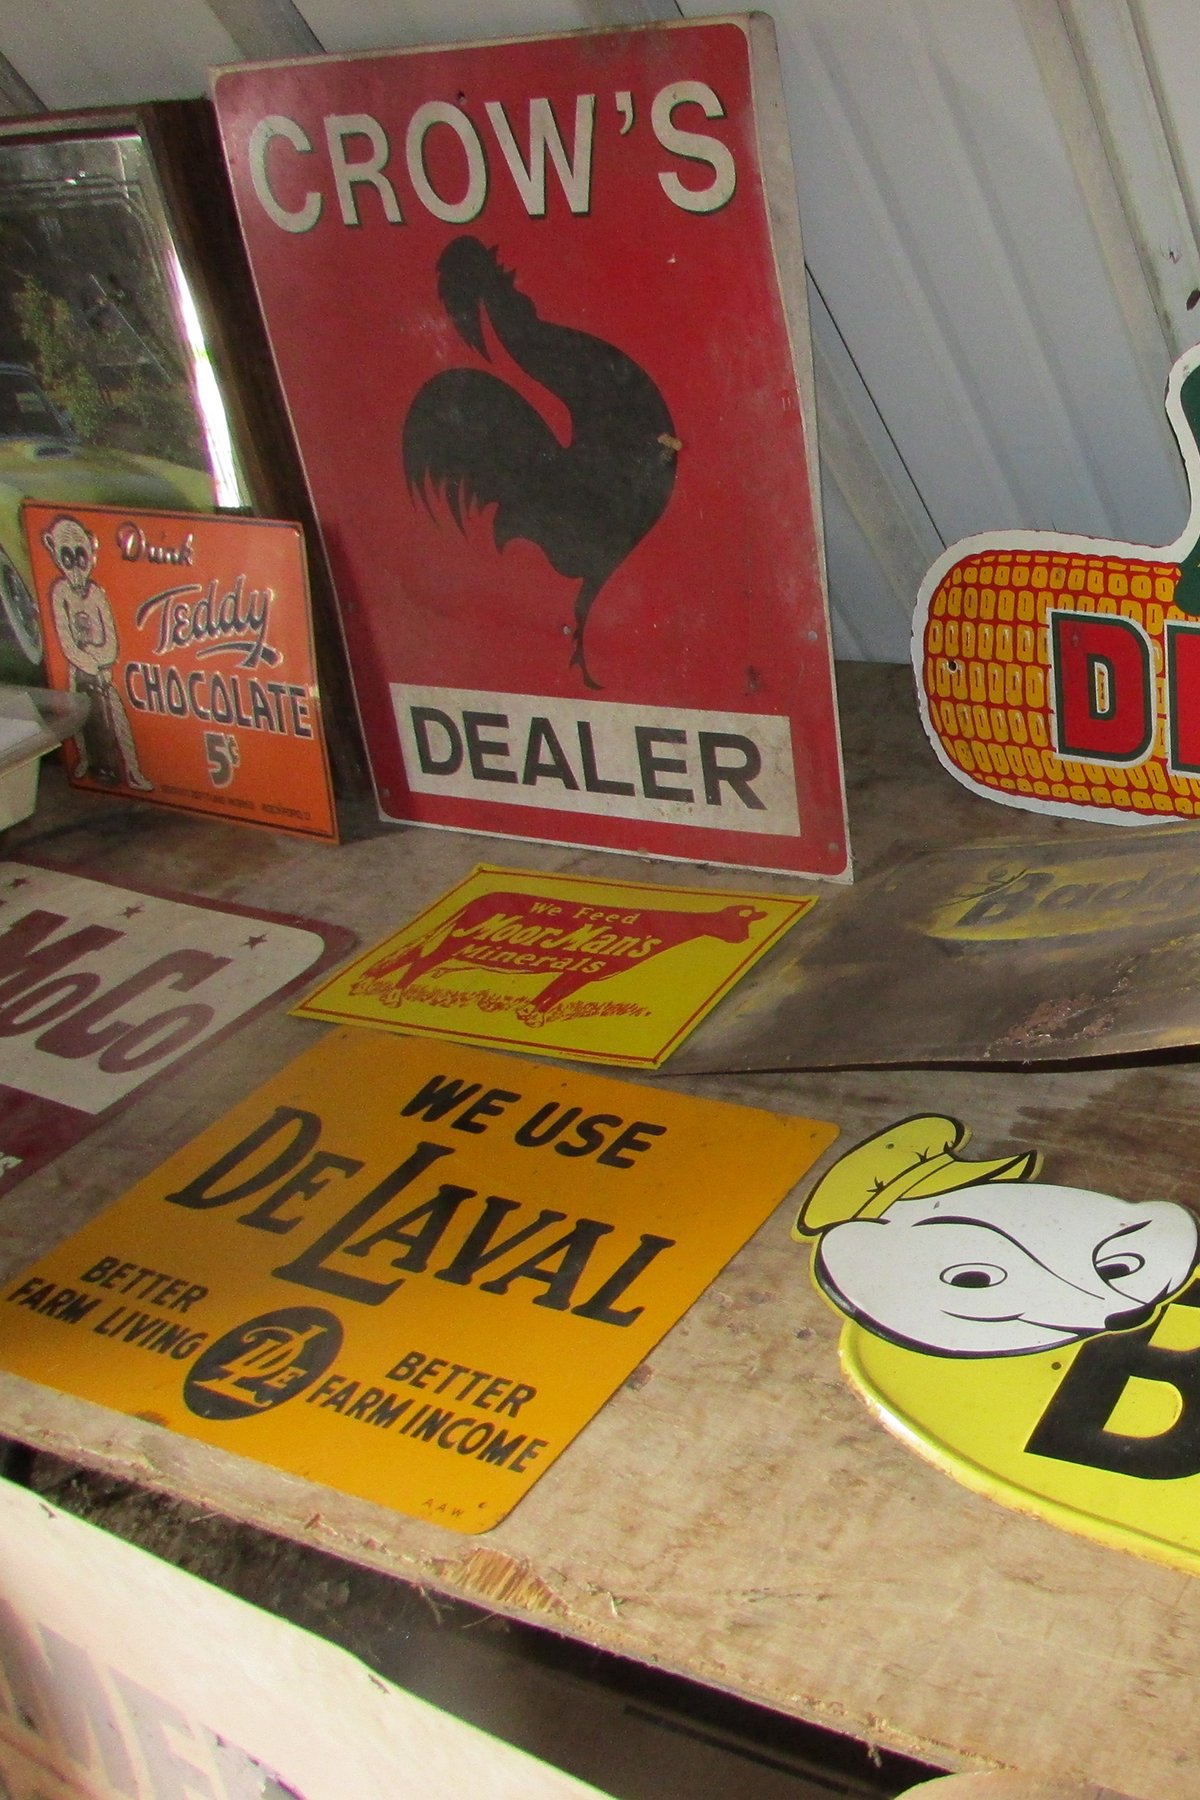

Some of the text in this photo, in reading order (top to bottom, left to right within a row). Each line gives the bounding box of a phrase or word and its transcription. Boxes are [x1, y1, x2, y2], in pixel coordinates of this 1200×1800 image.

[248, 80, 739, 234] CROW'S
[136, 573, 284, 669] Teddy
[124, 661, 315, 740] CHOCOLATE
[409, 705, 768, 811] DEALER
[529, 902, 641, 925] We Feed
[452, 944, 606, 974] Minerals
[401, 1074, 667, 1169] WE USE
[8, 1277, 208, 1360] FARM LIVING
[79, 1256, 209, 1314] BETTER
[305, 1374, 550, 1474] FARM INCOME
[385, 1351, 538, 1418] BETTER
